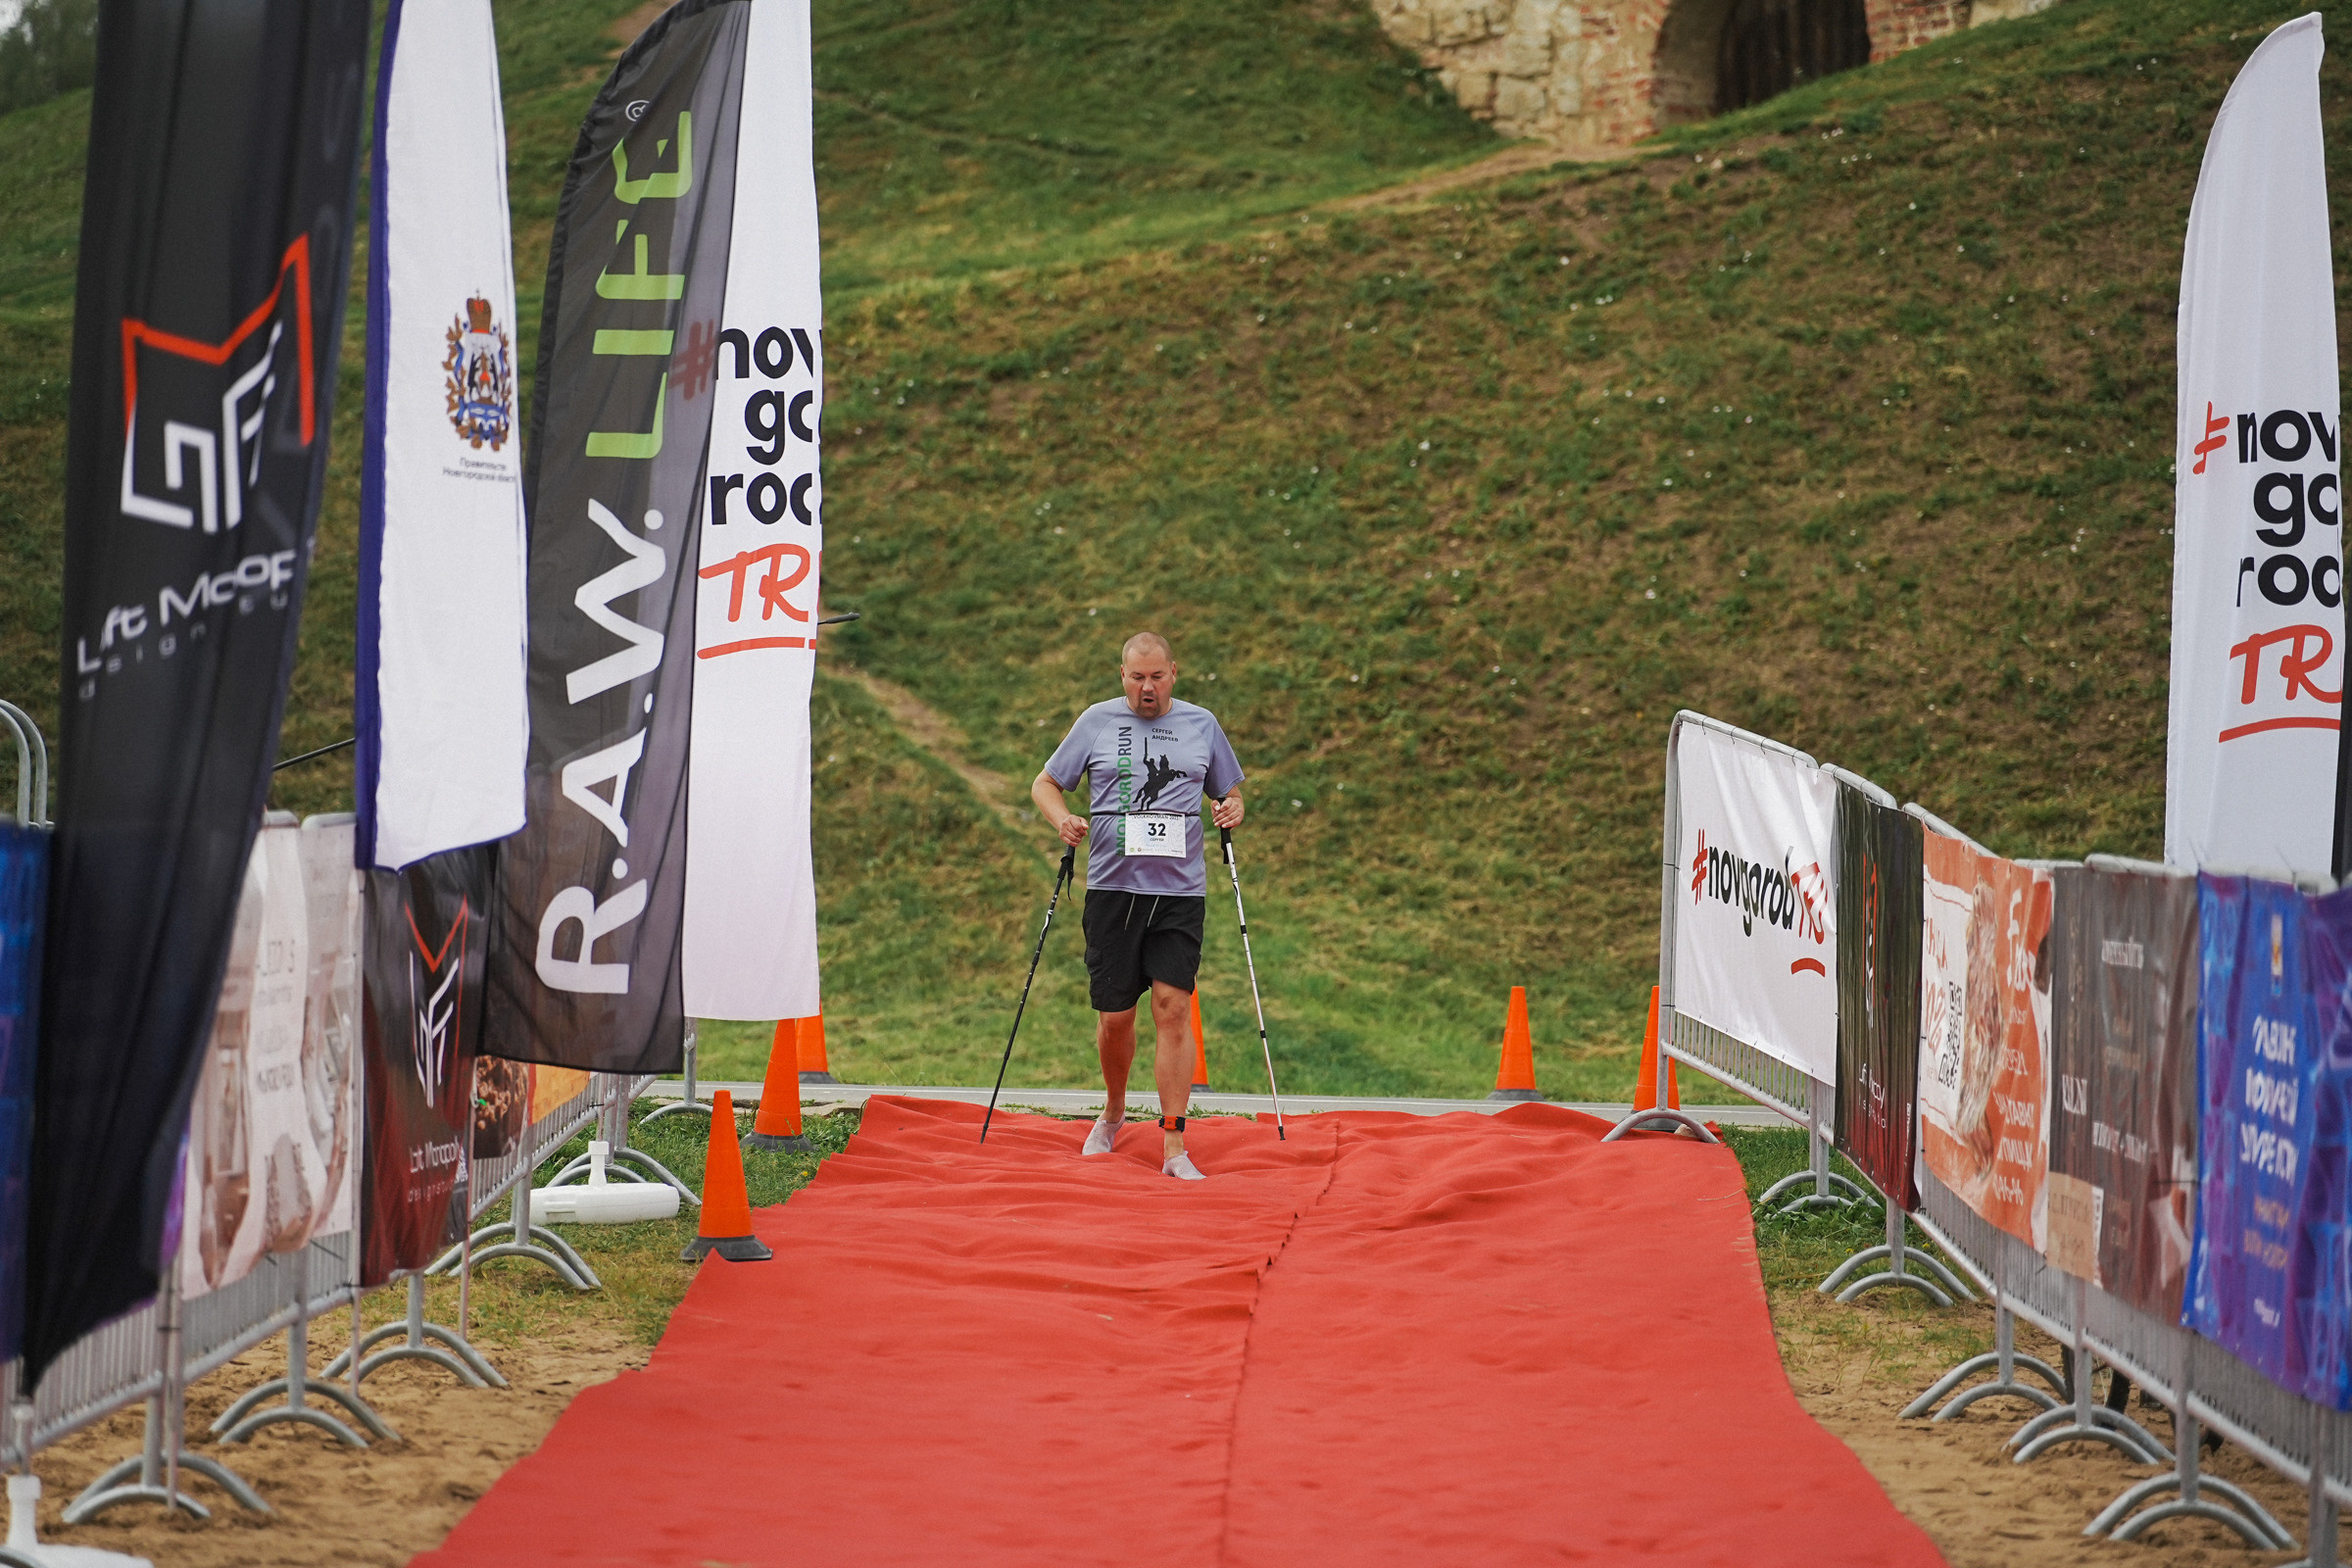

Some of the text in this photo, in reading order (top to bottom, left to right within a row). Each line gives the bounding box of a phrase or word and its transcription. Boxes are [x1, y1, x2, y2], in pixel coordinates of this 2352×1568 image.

[1152, 727, 1173, 736] СЕРГЕЙ
[1152, 734, 1179, 743] АНДРЕЕВ
[1148, 822, 1166, 837] 32
